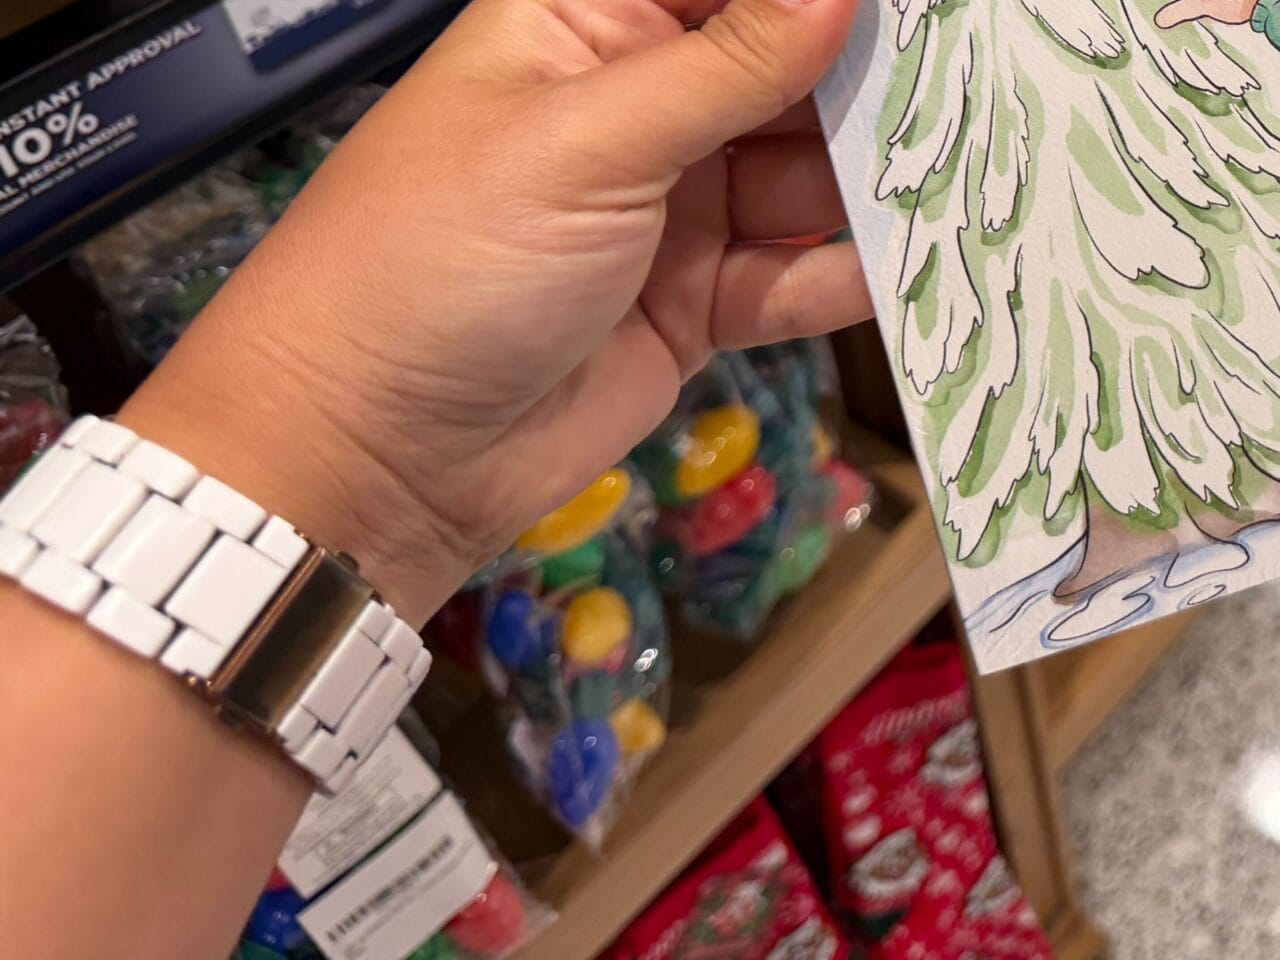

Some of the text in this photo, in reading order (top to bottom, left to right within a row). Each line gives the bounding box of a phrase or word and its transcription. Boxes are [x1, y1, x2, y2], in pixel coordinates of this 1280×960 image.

[0, 19, 202, 140] NSTANT APPROVAL
[0, 101, 100, 180] 10%
[18, 113, 139, 189] MERCHANDISE
